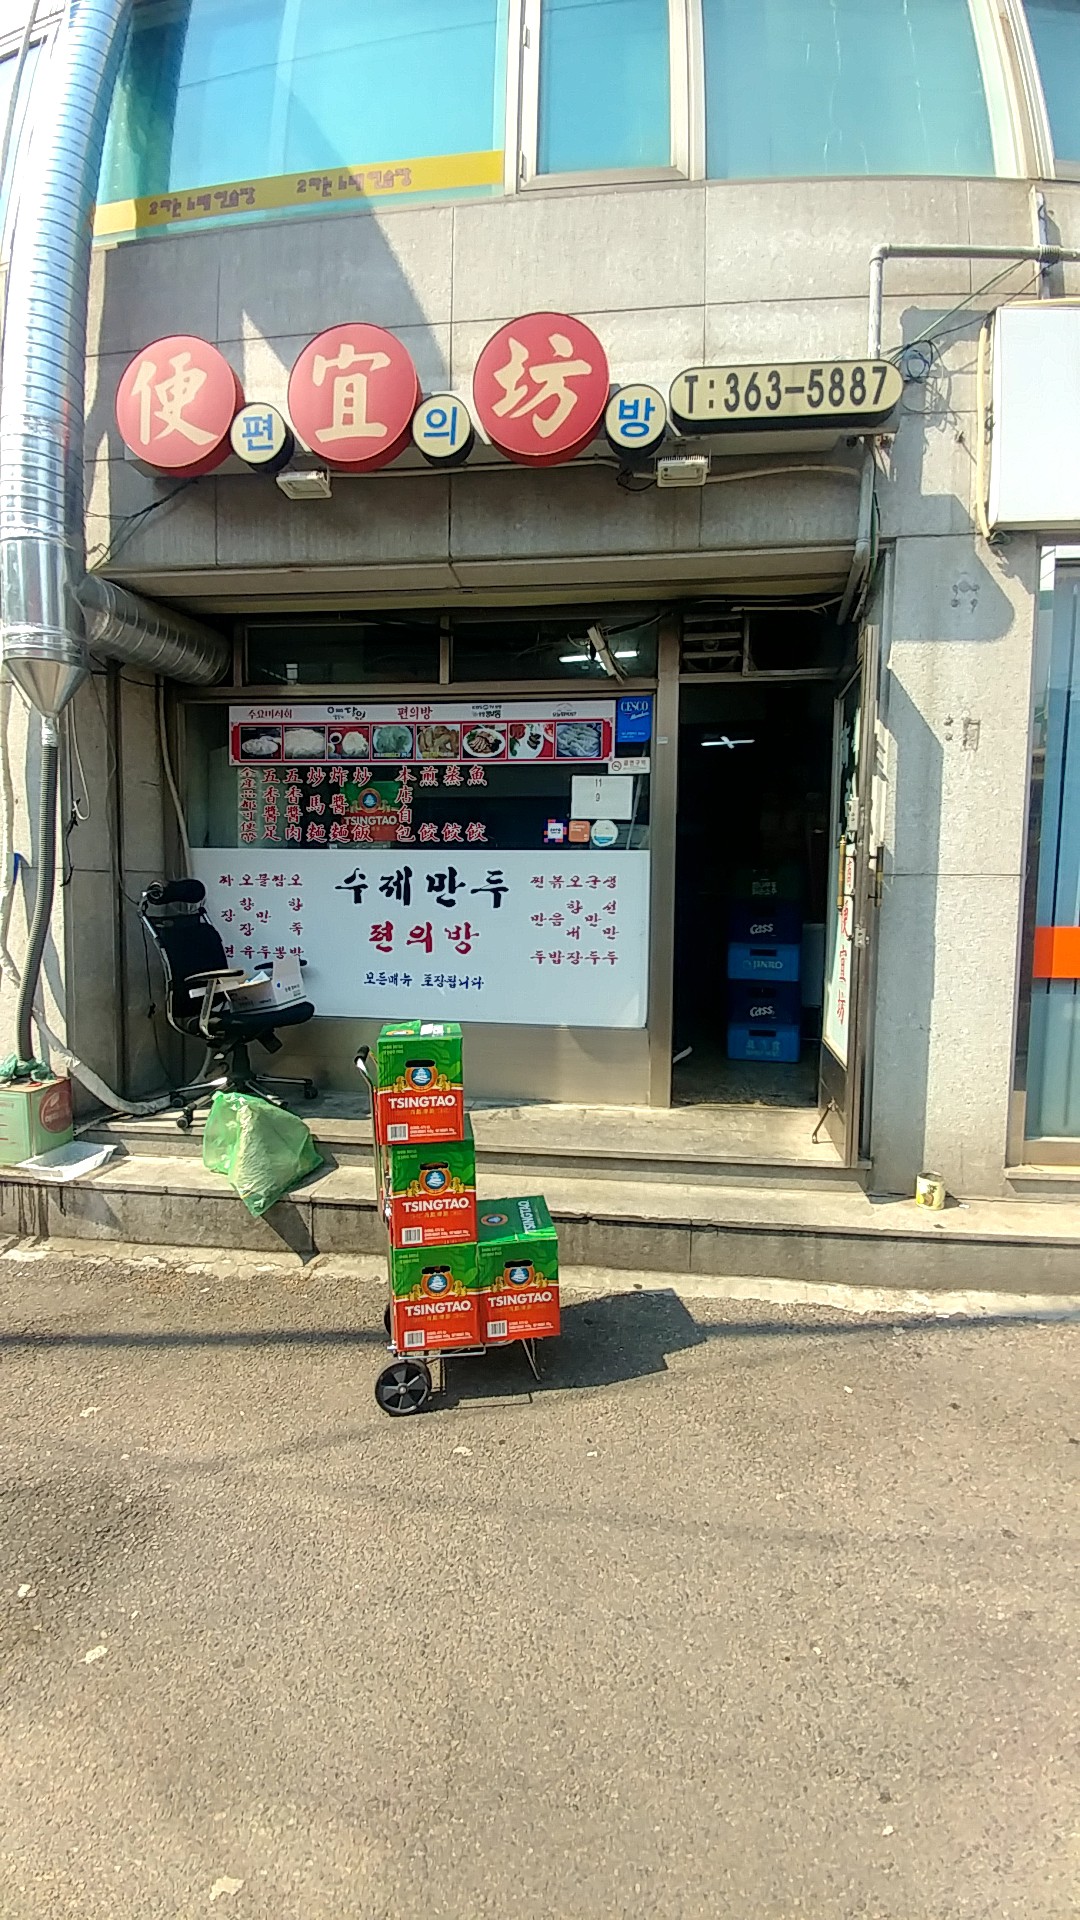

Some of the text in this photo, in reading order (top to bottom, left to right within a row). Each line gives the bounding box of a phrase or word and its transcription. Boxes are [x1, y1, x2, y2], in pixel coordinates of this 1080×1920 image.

[312, 344, 392, 444] 宜
[492, 332, 593, 426] 坊
[131, 351, 219, 446] 便
[242, 413, 273, 452] 편
[423, 406, 458, 446] 의
[618, 397, 656, 438] 방
[397, 706, 434, 721] 편의방
[620, 701, 649, 712] CESCO
[344, 815, 398, 826] TSINGTAO
[334, 866, 510, 909] 수제만두
[369, 921, 480, 955] 편의방
[753, 960, 783, 970] JINRO
[388, 1094, 456, 1109] TSINGTAO
[402, 1197, 470, 1213] TSINGTAO
[518, 1200, 536, 1233] TSINGTAO
[404, 1300, 472, 1317] TSINGTAO
[487, 1291, 553, 1308] TSINGTAO
